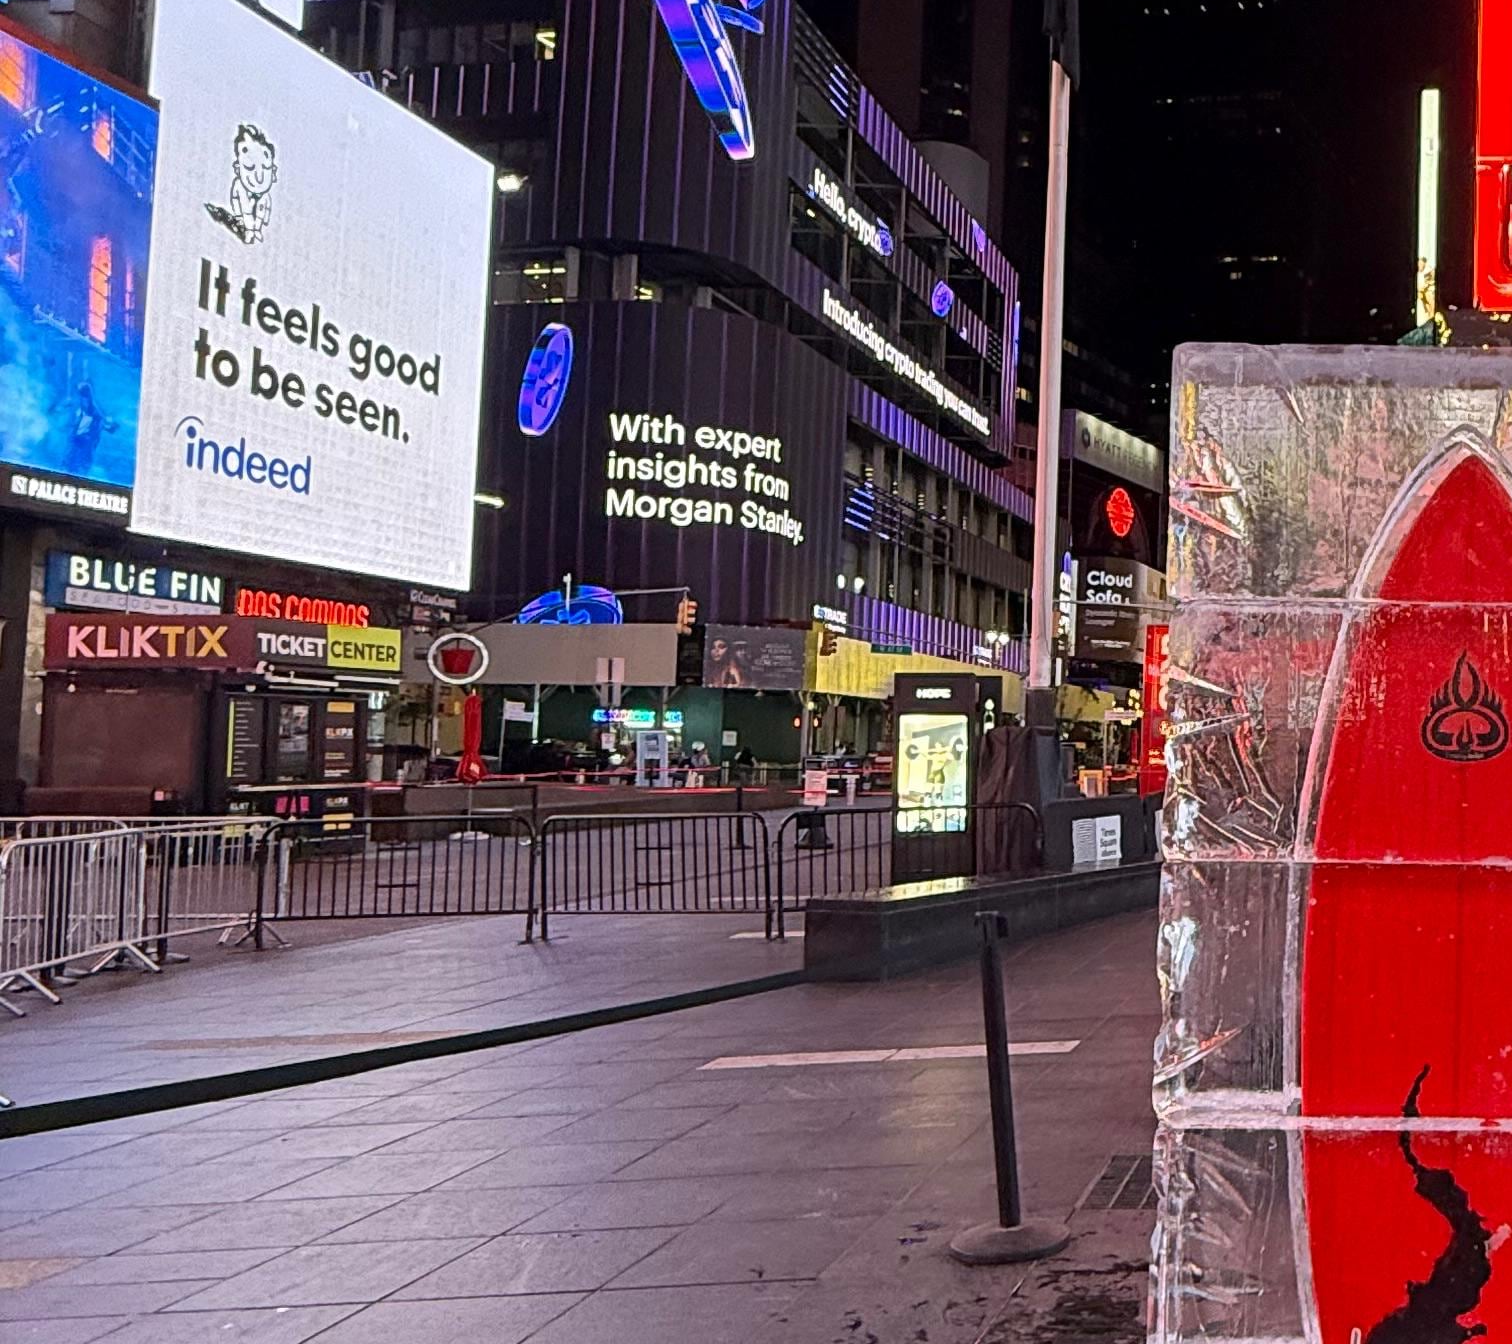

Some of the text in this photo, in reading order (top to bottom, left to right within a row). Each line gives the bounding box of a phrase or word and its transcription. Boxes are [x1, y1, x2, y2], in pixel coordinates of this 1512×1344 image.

[814, 168, 847, 222] Hello,
[197, 258, 442, 397] It feels good
[823, 288, 885, 360] Introducing
[885, 341, 915, 379] crypto
[194, 328, 412, 445] to be seen.
[174, 415, 313, 497] indeed
[608, 413, 783, 464] With expert
[29, 478, 128, 515] PALACE THEATRE
[607, 451, 790, 503] insights from
[606, 489, 805, 548] Morgan Stanley.
[70, 555, 221, 604] BLUE FIN
[1087, 570, 1133, 589] Cloud
[68, 625, 228, 658] KLIKTIX
[258, 633, 396, 662] TICKET CENTER
